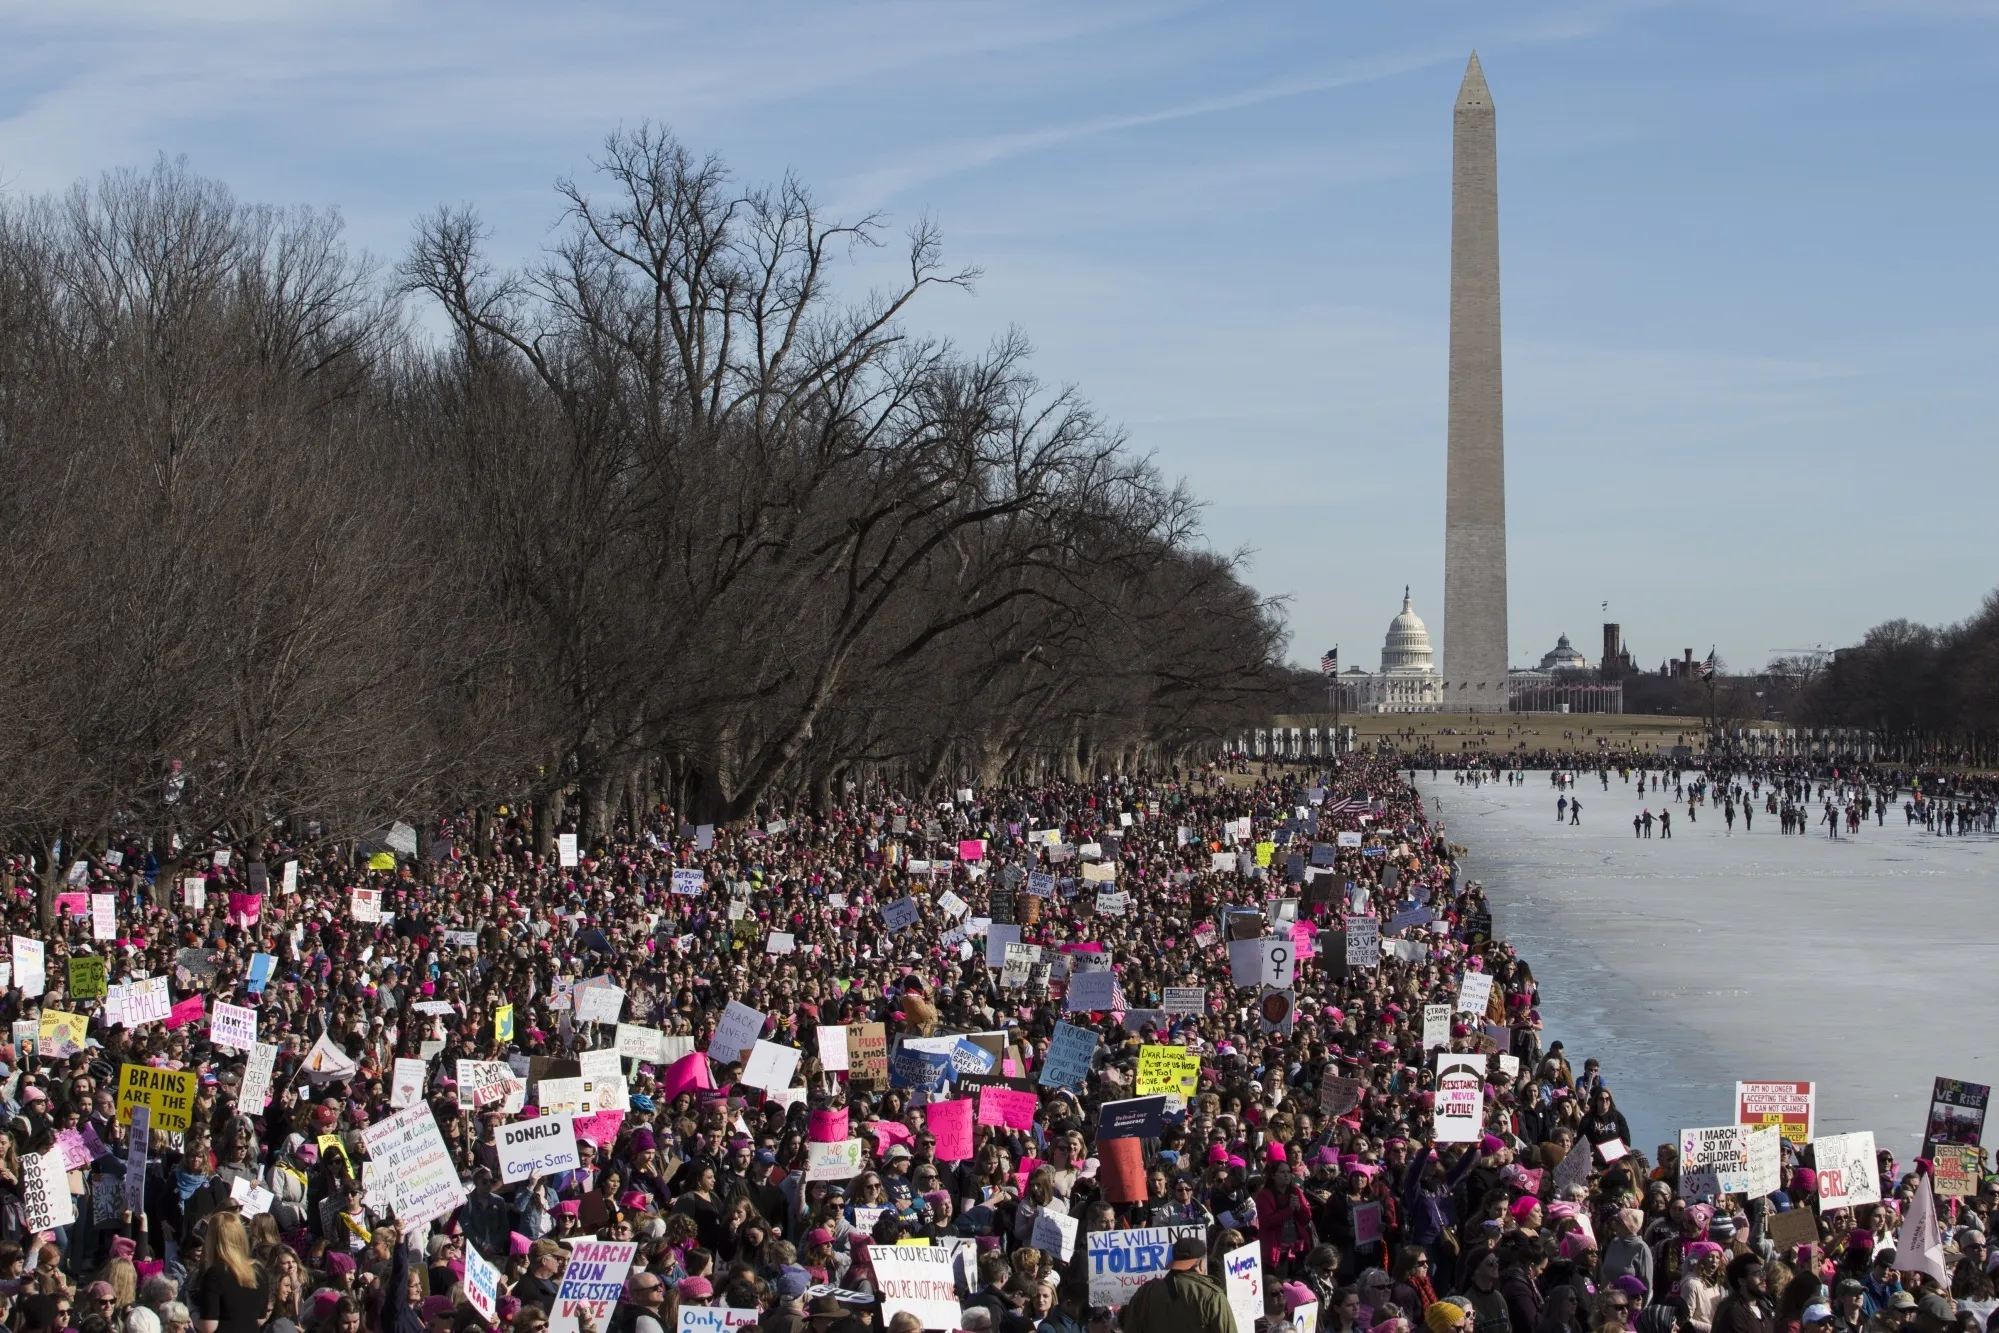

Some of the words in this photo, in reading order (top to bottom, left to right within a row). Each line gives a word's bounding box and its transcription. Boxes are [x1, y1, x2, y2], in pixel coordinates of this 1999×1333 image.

[1030, 872, 1054, 884] BROADS
[1031, 880, 1049, 889] SAVE
[1026, 886, 1050, 896] AMERICA
[889, 911, 912, 929] SEXY
[1006, 943, 1034, 955] TIME
[1049, 953, 1066, 962] FAKE
[70, 961, 91, 973] Silence
[71, 986, 103, 998] Complicity
[120, 986, 134, 998] THE
[133, 980, 154, 995] FUTURE
[155, 977, 166, 990] IS
[1461, 992, 1488, 1000] RESISTING
[121, 990, 169, 1023] FEMALE
[213, 1003, 255, 1021] FEMINISM
[1425, 1006, 1450, 1016] STRONG
[1460, 1001, 1485, 1010] VOTE
[222, 1016, 231, 1025] IS
[231, 1017, 241, 1027] MY
[725, 1008, 756, 1032] BLACK
[1425, 1015, 1449, 1023] WOMEN
[16, 1024, 34, 1032] TIME
[212, 1021, 254, 1040] FAVORITE
[720, 1024, 748, 1044] LIVES
[849, 1027, 864, 1036] MY
[1061, 1025, 1074, 1037] NO
[1076, 1030, 1094, 1042] ONE
[216, 1034, 248, 1048] F-WORD
[623, 1039, 647, 1047] DEVOTED
[858, 1037, 885, 1047] PUSSY
[255, 1043, 272, 1058] YOU
[863, 1048, 886, 1058] MADE
[1141, 1049, 1161, 1060] DEAR
[852, 1060, 864, 1068] OF
[895, 1062, 916, 1073] SAFE
[918, 1068, 941, 1076] LEGAL
[953, 1056, 972, 1069] SAFE
[1072, 1062, 1088, 1074] YOUR
[1144, 1060, 1162, 1068] MOST
[1181, 1061, 1196, 1070] HATE
[246, 1069, 266, 1084] SEEN
[474, 1069, 482, 1079] A
[850, 1069, 868, 1079] and
[872, 1068, 881, 1077] it
[904, 1071, 937, 1083] ACCESSIBLE
[1155, 1068, 1172, 1076] TOO!
[129, 1068, 185, 1094] BRAINS
[960, 1080, 980, 1091] I'm
[1441, 1079, 1478, 1090] RESISTANCE
[1936, 1077, 1989, 1097] TOGETHER
[243, 1083, 267, 1098] NASTY
[1152, 1084, 1182, 1094] AMERICA
[1936, 1088, 1952, 1102] WE
[123, 1088, 152, 1105] ARE
[162, 1094, 187, 1110] THE
[1451, 1091, 1475, 1101] NEVER
[241, 1098, 262, 1114] YET!
[1445, 1103, 1474, 1114] FUTILE!
[1754, 1104, 1767, 1112] CAN
[1768, 1104, 1779, 1112] NOT
[1781, 1104, 1804, 1112] CHANGE
[158, 1112, 186, 1129] TITS
[1113, 1118, 1146, 1127] democracy
[1115, 1113, 1136, 1121] Defend
[1770, 1114, 1780, 1122] AM
[363, 1133, 369, 1144] I
[371, 1127, 388, 1141] march
[387, 1122, 396, 1135] for
[395, 1116, 405, 1129] All
[405, 1117, 414, 1127] my
[950, 1119, 962, 1131] TO
[1784, 1124, 1803, 1132] THINGS
[505, 1122, 561, 1145] DONALD
[1700, 1131, 1703, 1140] I
[1705, 1128, 1738, 1141] MARCH
[371, 1145, 382, 1159] All
[382, 1138, 401, 1154] Races
[403, 1131, 413, 1144] All
[1703, 1141, 1716, 1151] SO
[1720, 1140, 1733, 1151] MY
[1815, 1135, 1849, 1158] FIGHT
[1936, 1145, 1970, 1157] RESIST
[388, 1152, 400, 1168] All
[400, 1136, 438, 1161] Ethnicities
[1697, 1150, 1740, 1163] CHILDREN
[19, 1153, 39, 1166] PRO
[507, 1158, 543, 1175] Comic
[545, 1152, 573, 1168] Sans
[821, 1155, 844, 1165] Shall
[1818, 1155, 1839, 1170] LIKE
[1841, 1154, 1849, 1168] A
[1942, 1157, 1959, 1165] HATE
[382, 1171, 396, 1188] All
[396, 1163, 419, 1179] Gender
[417, 1151, 446, 1171] Identities
[1715, 1162, 1737, 1173] HAVE
[1738, 1162, 1748, 1172] TO
[1940, 1163, 1959, 1172] FEAR
[1934, 1170, 1969, 1179] JUDGMENT
[25, 1178, 43, 1192] PRO
[395, 1181, 409, 1198] All
[408, 1167, 444, 1189] Religions
[1817, 1169, 1848, 1199] GIRL
[1936, 1178, 1970, 1190] RESIST
[24, 1190, 46, 1205] PRO
[396, 1198, 408, 1214] All
[409, 1180, 451, 1206] Capabilities
[434, 1192, 460, 1211] Equally
[26, 1201, 49, 1217] PRO
[29, 1214, 51, 1230] PRO
[1090, 1231, 1120, 1249] WE
[1123, 1229, 1167, 1247] WILL
[468, 1249, 476, 1266] WE
[572, 1243, 633, 1263] MARCH
[869, 1247, 888, 1261] IF
[930, 1247, 950, 1264] NOT
[480, 1263, 493, 1280] ARE
[565, 1261, 607, 1281] RUN
[467, 1260, 496, 1299] STRONGER
[468, 1279, 489, 1312] FEAR
[560, 1280, 623, 1301] REGISTER
[914, 1280, 931, 1300] NOT
[683, 1310, 723, 1332] Only
[725, 1310, 757, 1327] Love
